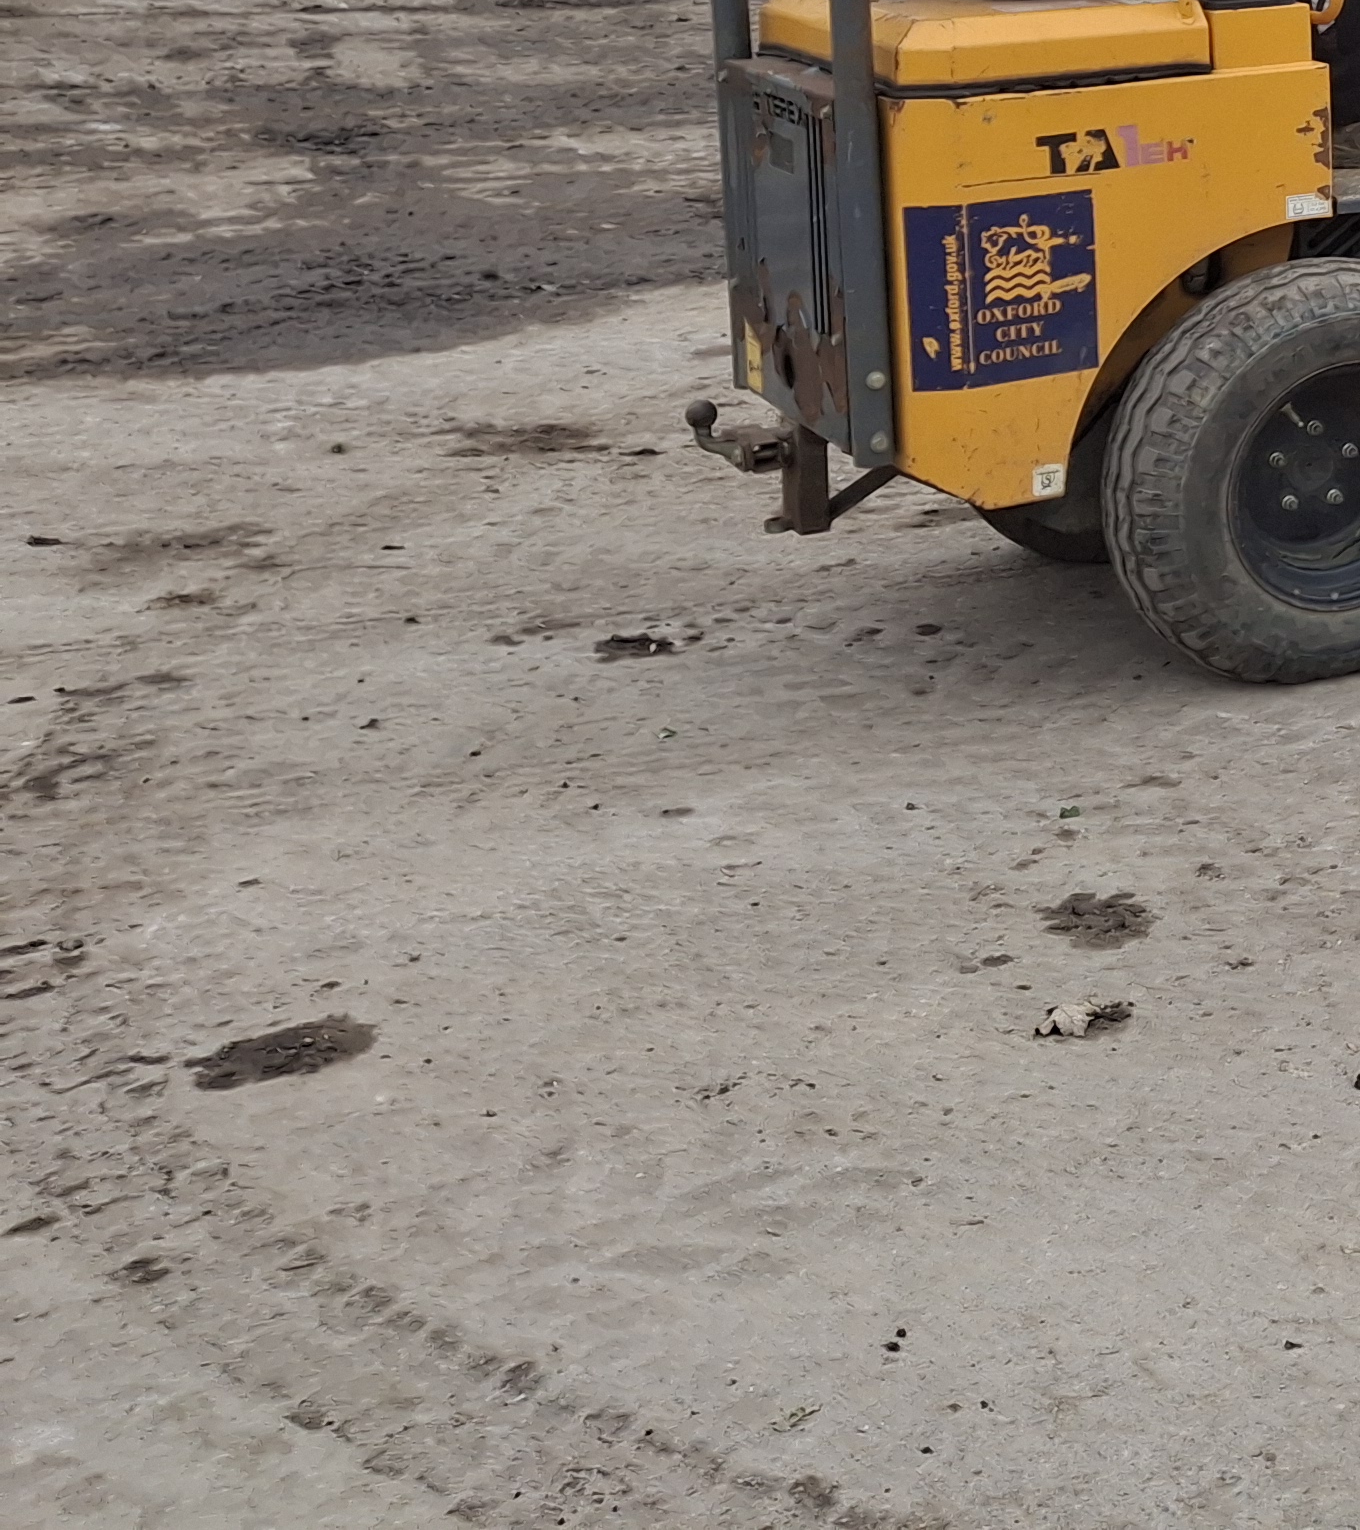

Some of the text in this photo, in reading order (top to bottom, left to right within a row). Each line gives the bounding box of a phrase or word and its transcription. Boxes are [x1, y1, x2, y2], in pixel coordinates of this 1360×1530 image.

[942, 233, 963, 372] www.oxford.gov.uk
[976, 299, 1063, 326] OXFORD
[995, 321, 1045, 343] CITY
[978, 339, 1063, 366] COUNCIL
